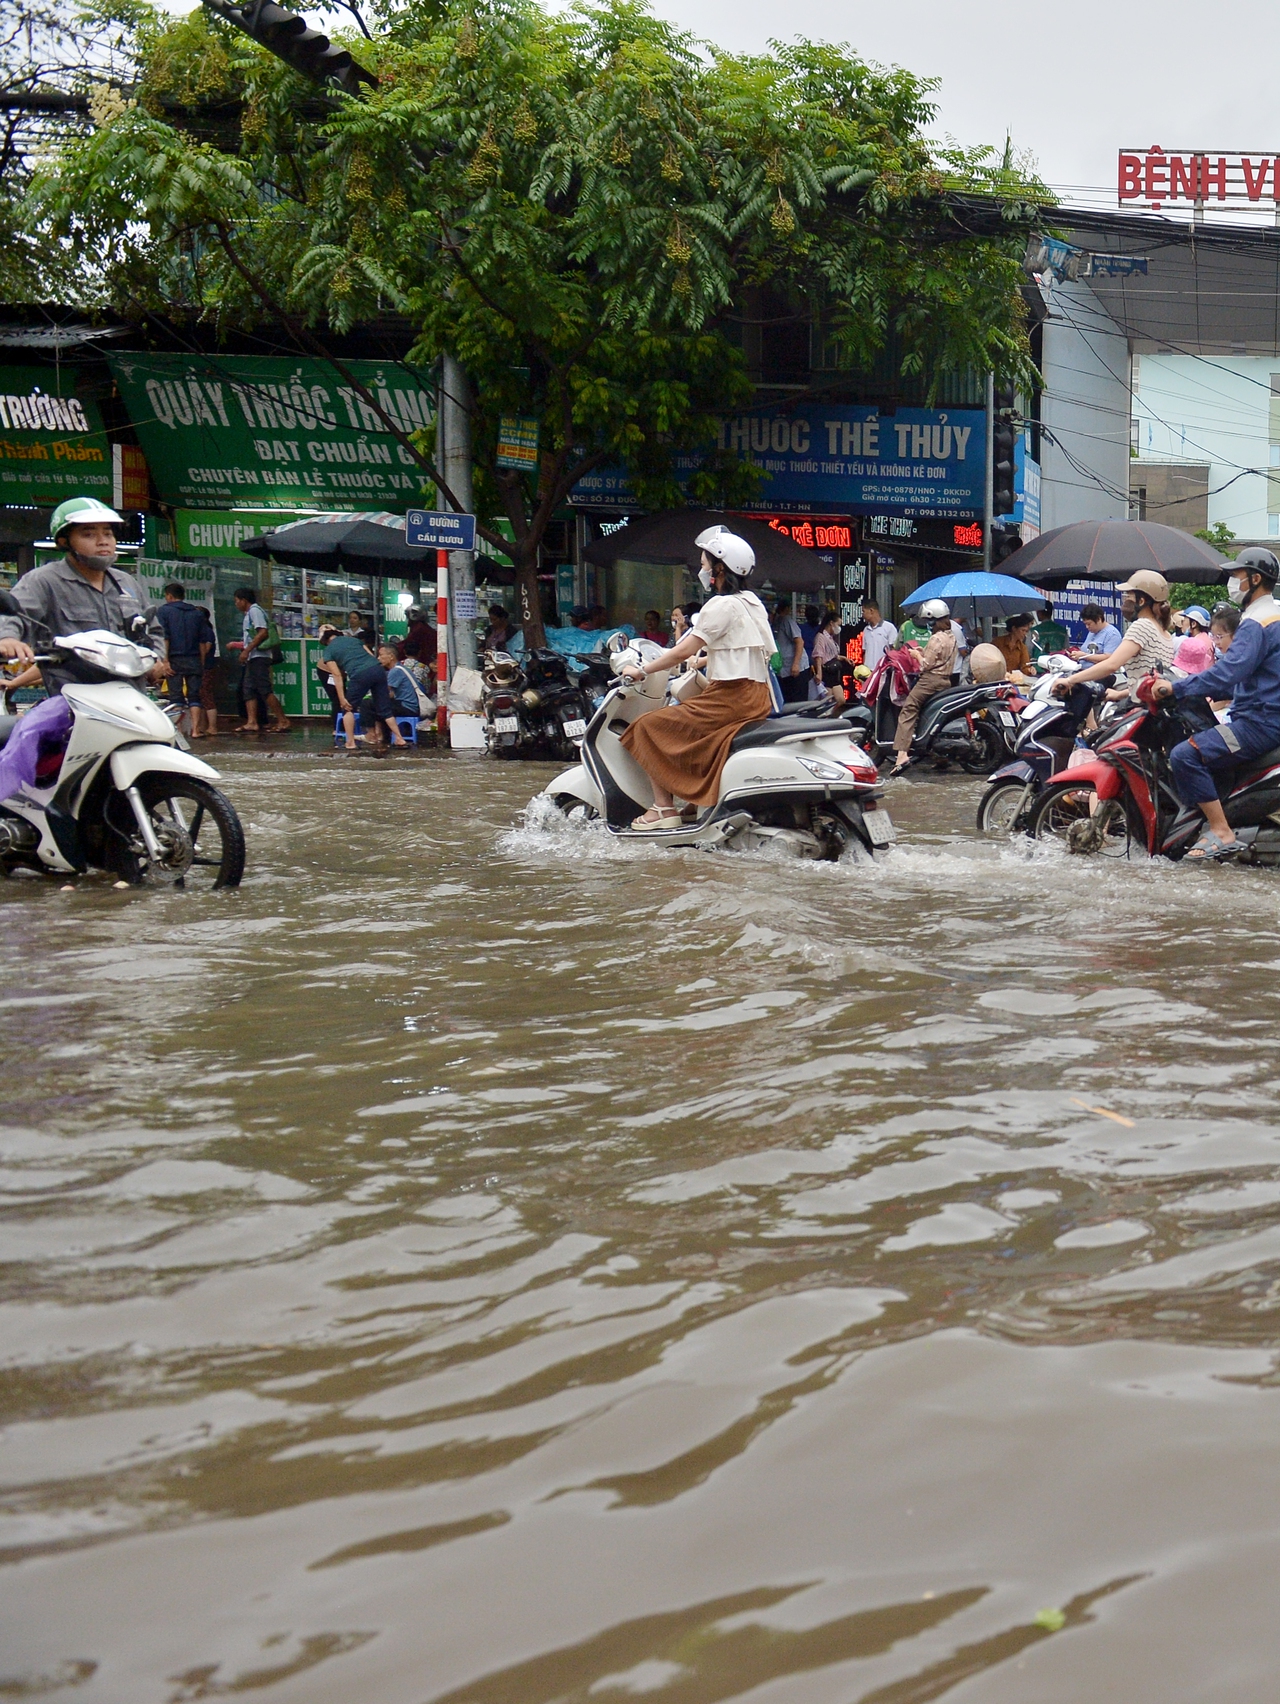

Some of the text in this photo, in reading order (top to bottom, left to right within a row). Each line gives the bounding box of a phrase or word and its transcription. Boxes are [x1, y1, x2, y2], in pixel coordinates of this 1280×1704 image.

[1118, 145, 1226, 210] BỆNH
[145, 365, 231, 430] QUẦY
[229, 367, 337, 431] THUỐC
[894, 413, 972, 460] THỦY
[253, 439, 301, 466] ĐẠT
[306, 434, 393, 464] CHUẨN
[187, 467, 260, 485] CHUYÊN
[261, 468, 301, 486] BÁN
[302, 467, 326, 487] LẺ
[327, 469, 386, 488] THUỐC
[388, 472, 415, 489] VÀ
[766, 457, 946, 479] MỤC THUỐC THIẾT YẾU VÀ KHÔNG KÊ ĐƠN
[862, 485, 881, 493] GPS:
[862, 493, 875, 501] Giờ
[910, 496, 930, 504] 6h30
[937, 497, 961, 505] 21h00
[429, 515, 460, 529] ĐƯỜNG
[904, 508, 975, 518] ĐT: 098 3132 031
[188, 518, 255, 548] CHUYÊN
[438, 534, 464, 545] BƯƠU
[816, 525, 851, 548] ĐƠN
[840, 594, 864, 627] THUỐ
